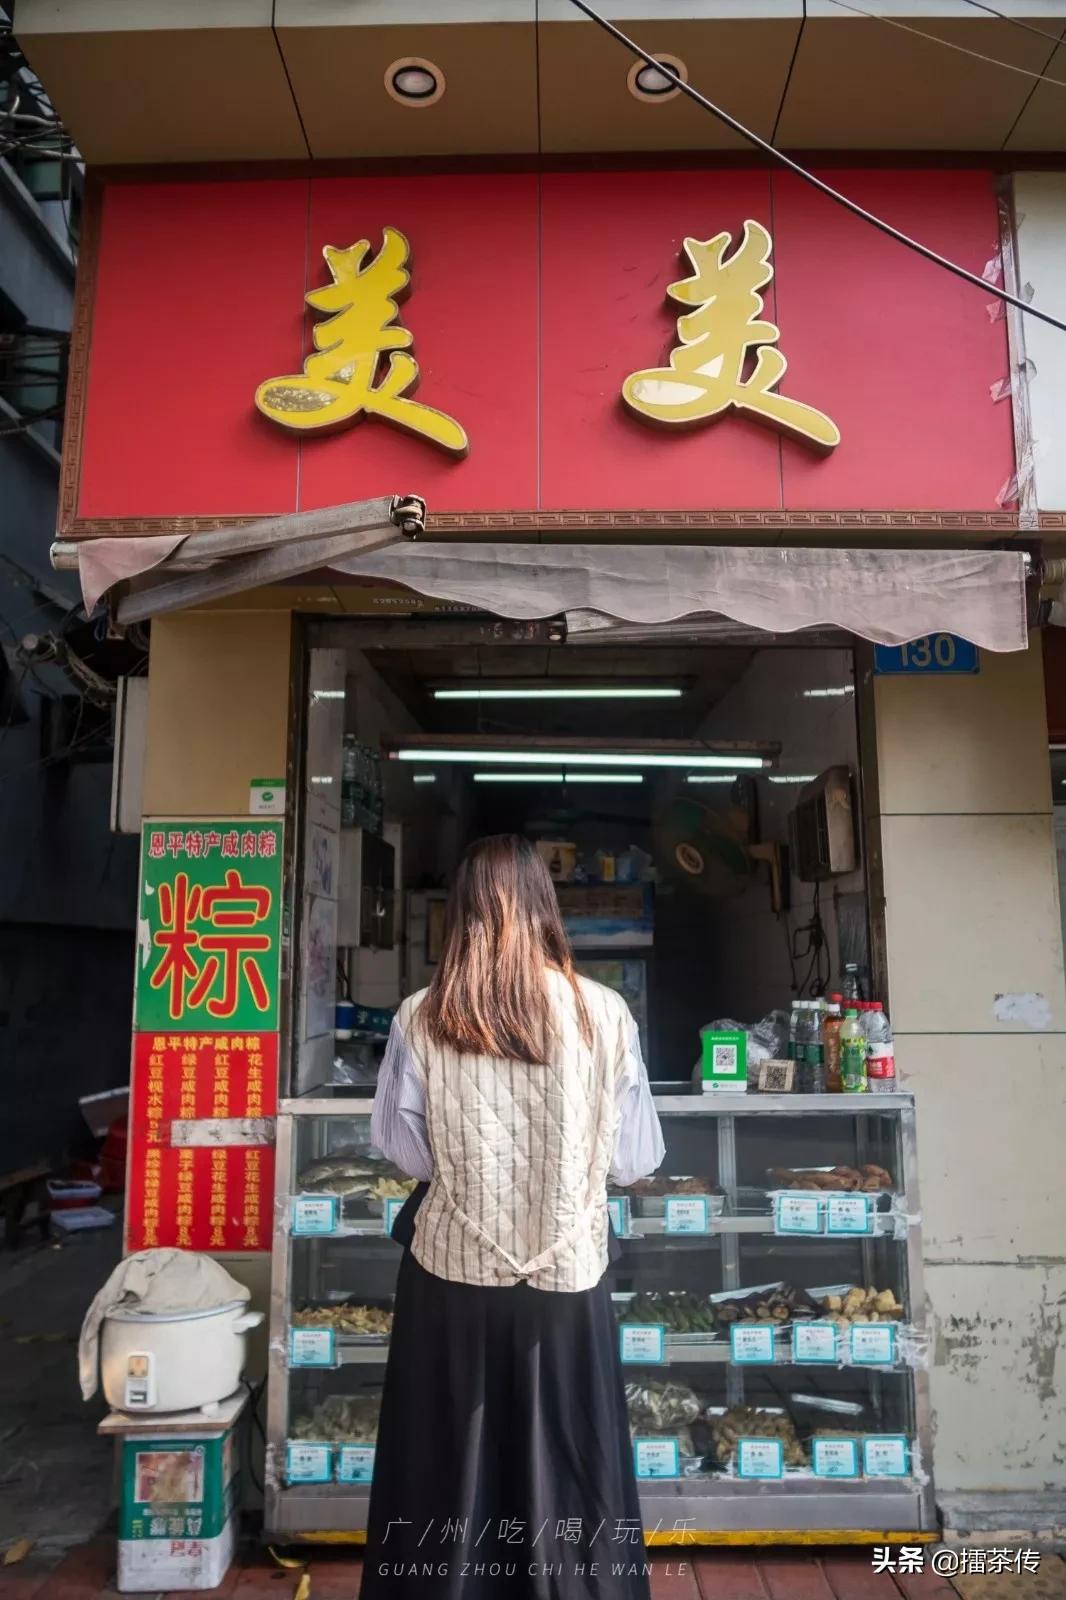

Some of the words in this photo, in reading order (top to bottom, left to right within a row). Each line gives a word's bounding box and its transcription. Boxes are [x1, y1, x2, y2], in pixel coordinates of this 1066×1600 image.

[901, 634, 955, 667] 130
[149, 831, 276, 858] 恩平特产咸肉粽
[150, 869, 272, 1020] 粽
[152, 1036, 260, 1051] 恩平特产咸肉粽
